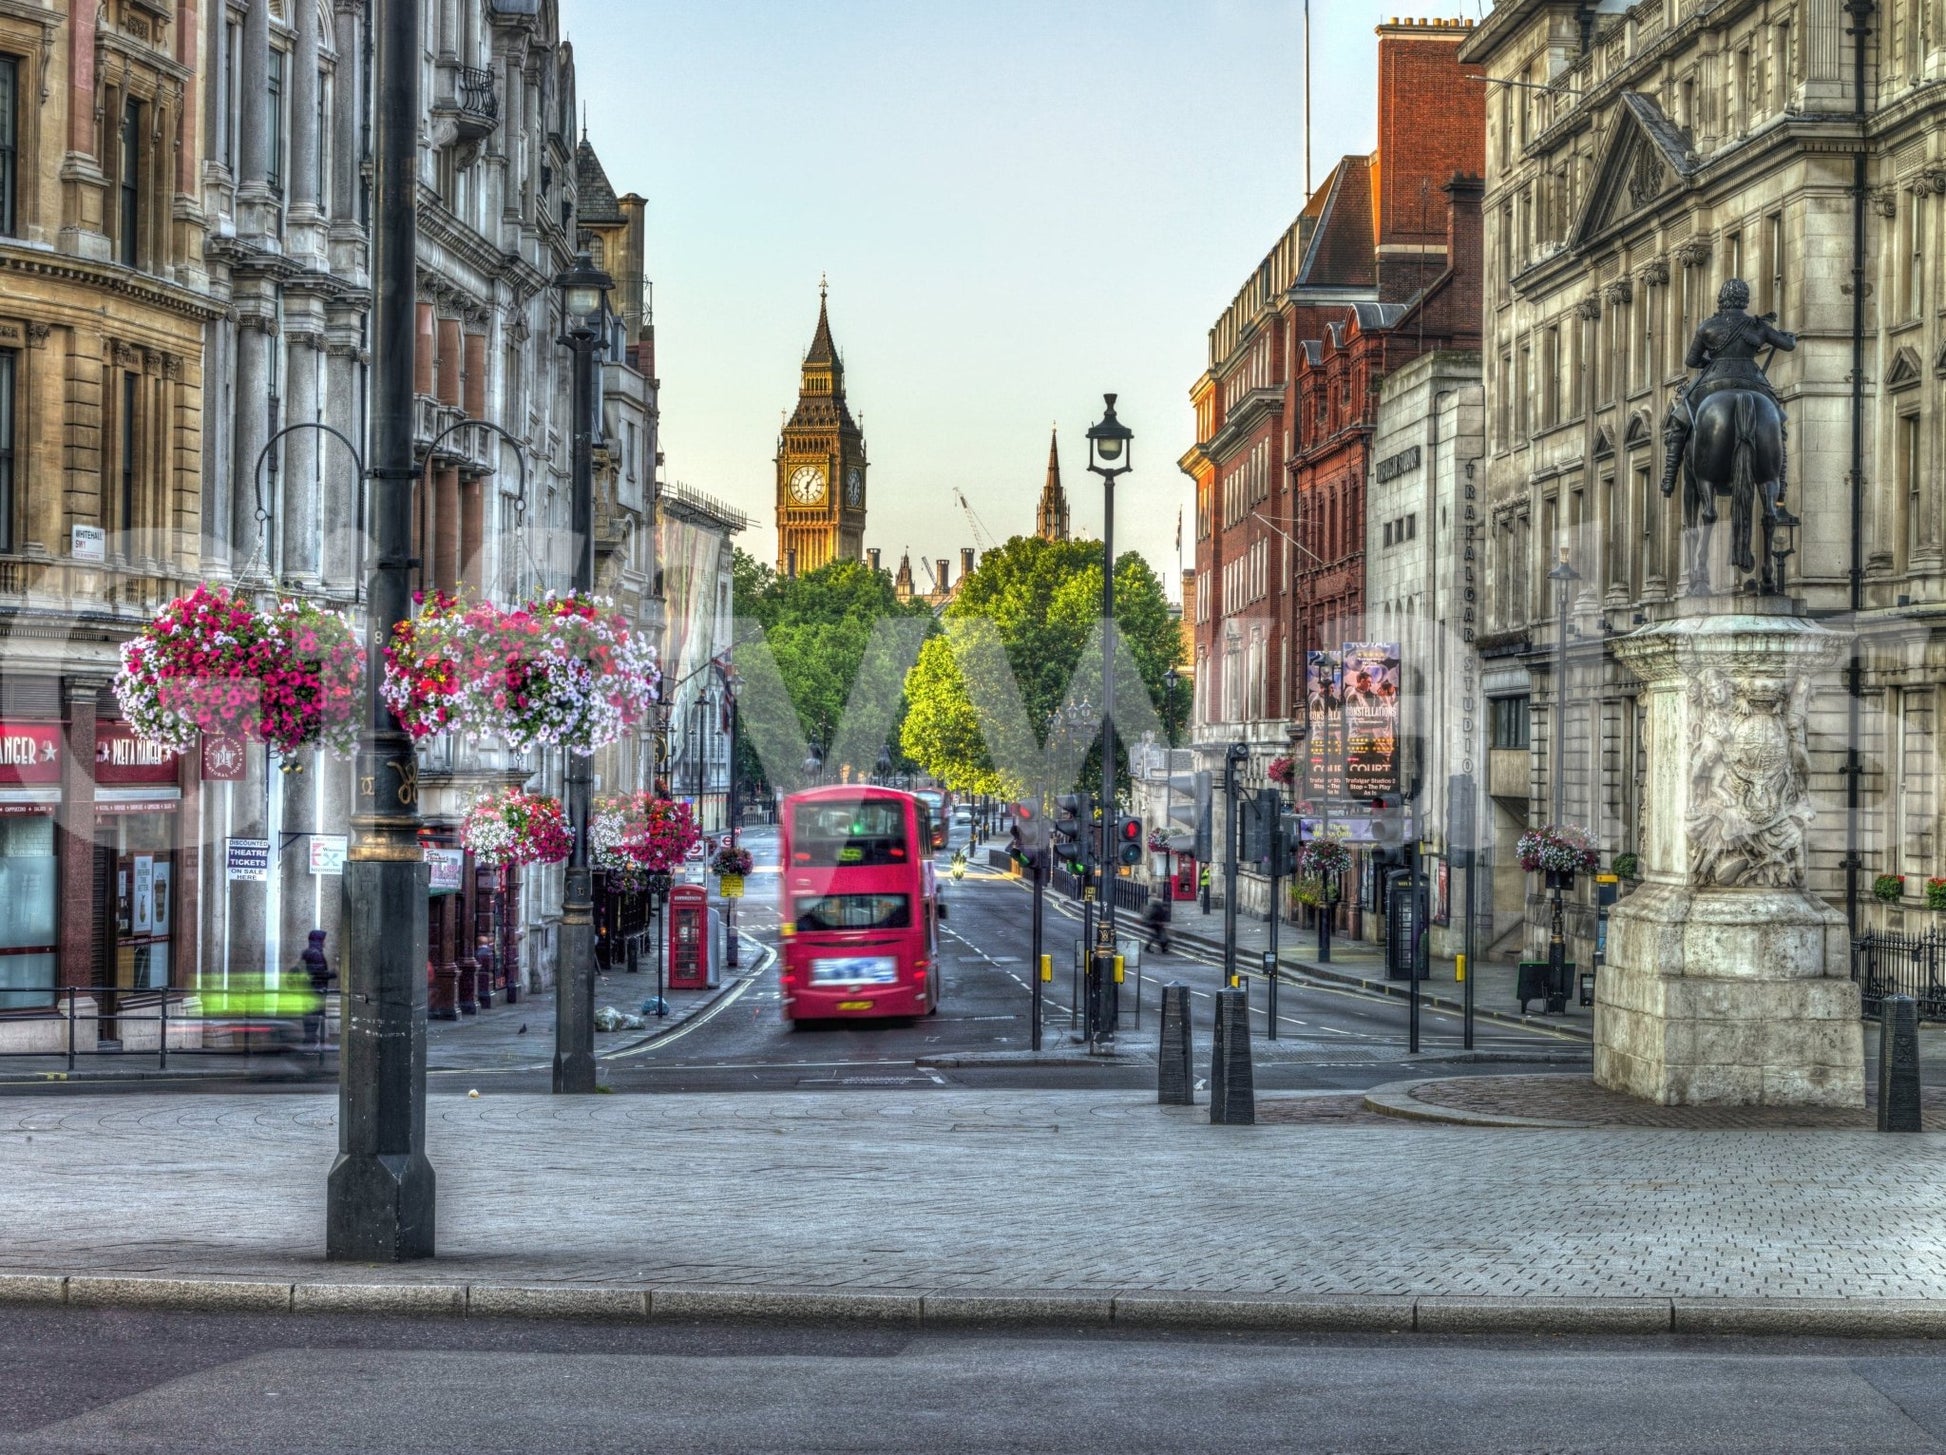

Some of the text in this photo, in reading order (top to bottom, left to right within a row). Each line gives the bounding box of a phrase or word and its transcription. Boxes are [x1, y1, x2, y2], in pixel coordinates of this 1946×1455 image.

[76, 530, 103, 540] WHITEHALL
[1464, 464, 1476, 642] TRAFALGAR
[1345, 777, 1370, 785] Trafalgar
[229, 849, 268, 857] THEATRE
[229, 858, 266, 867] TICKETS
